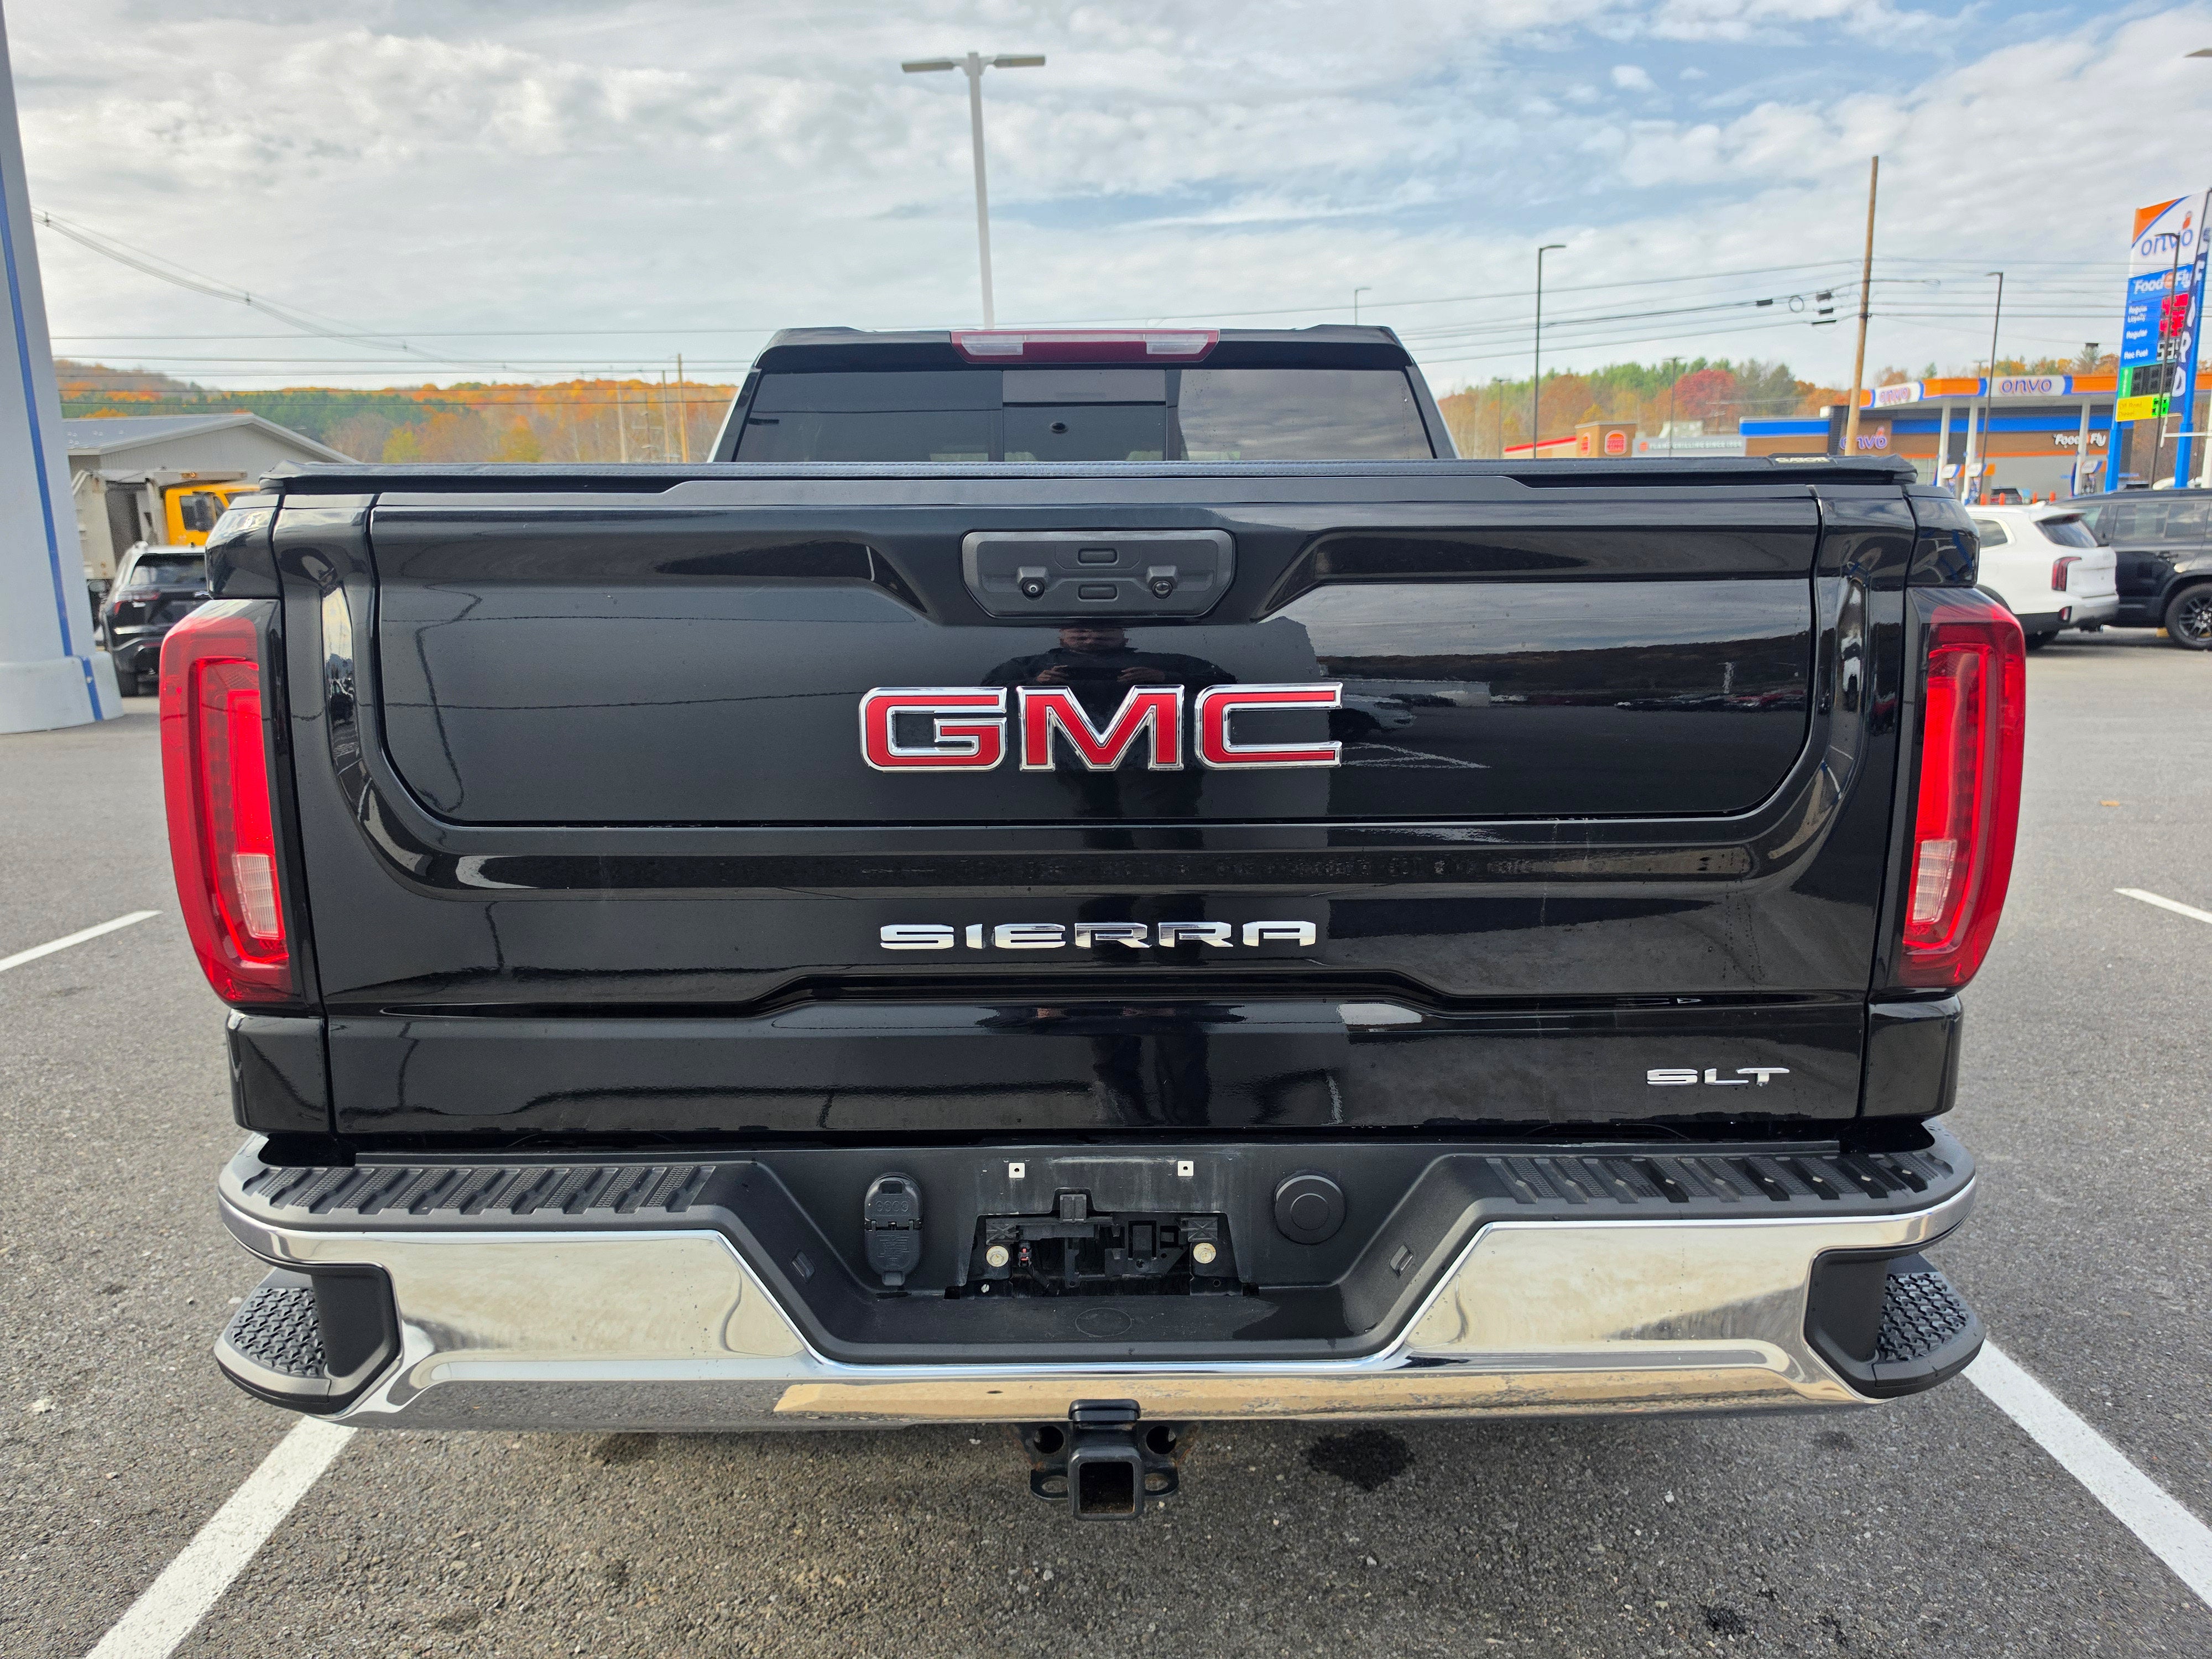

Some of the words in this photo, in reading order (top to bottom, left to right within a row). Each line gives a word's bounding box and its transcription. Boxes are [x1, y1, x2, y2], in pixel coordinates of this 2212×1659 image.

[2141, 229, 2193, 256] onvo
[2133, 273, 2166, 294] Food
[2126, 329, 2148, 340] Regular
[2135, 348, 2148, 357] Fuel
[1879, 387, 1911, 403] onvo
[2000, 378, 2052, 395] onvo
[2090, 432, 2106, 446] Fly
[859, 682, 1343, 771] GMC
[880, 921, 1317, 950] SIERRA
[1647, 1068, 1790, 1087] SLT
